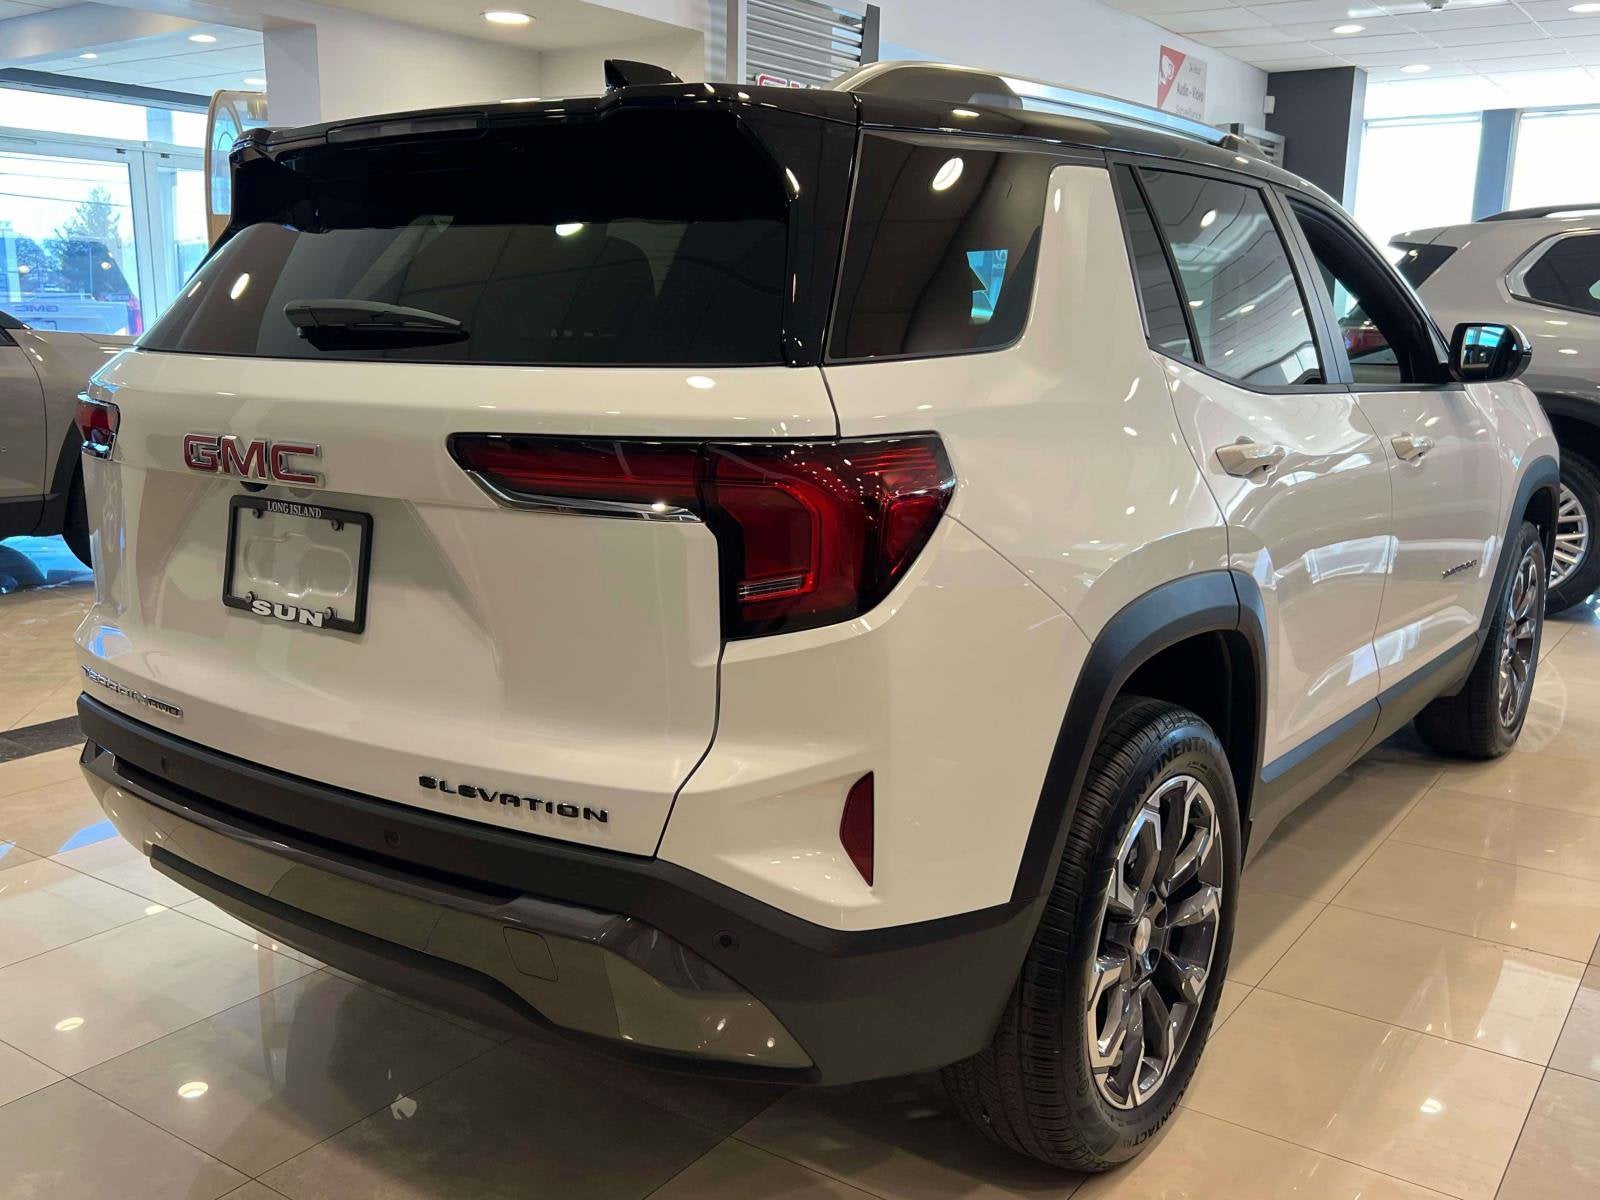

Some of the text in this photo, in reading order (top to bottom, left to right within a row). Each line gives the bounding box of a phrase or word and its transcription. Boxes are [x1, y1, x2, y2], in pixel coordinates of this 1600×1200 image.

[184, 433, 325, 487] GMC
[267, 501, 322, 519] LONG ISLAND
[251, 600, 324, 627] SUN
[418, 774, 609, 823] ELEVATION
